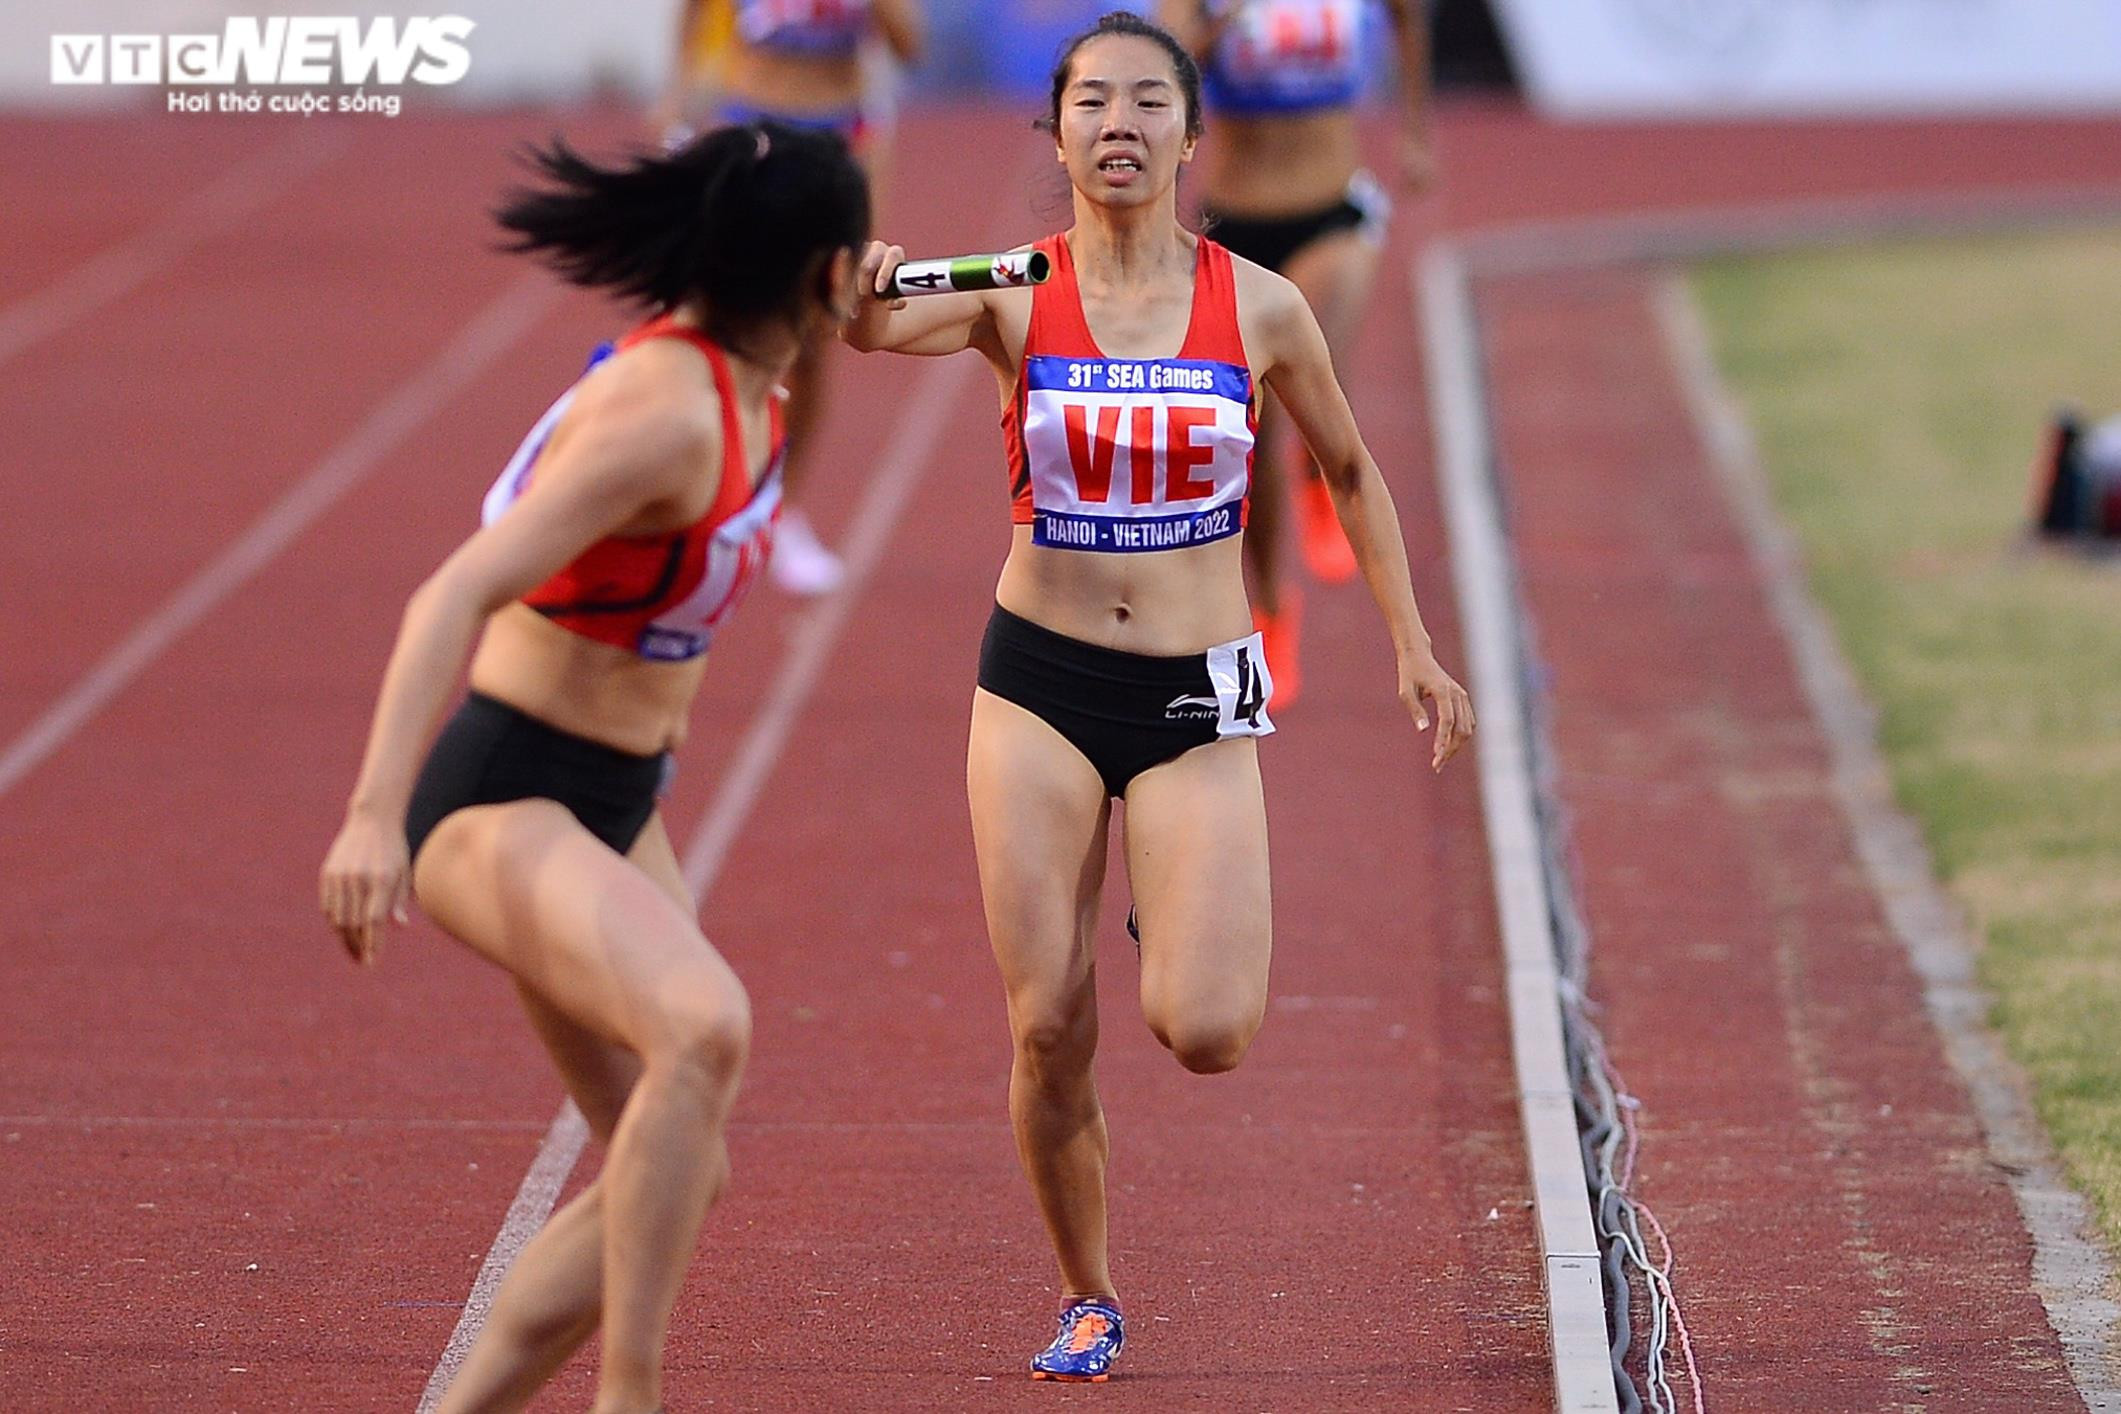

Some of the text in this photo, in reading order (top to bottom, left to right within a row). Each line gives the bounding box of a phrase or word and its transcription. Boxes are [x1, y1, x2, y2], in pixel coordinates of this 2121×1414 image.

[900, 272, 946, 288] 4
[1107, 365, 1145, 389] SEA
[1149, 365, 1214, 390] Games
[1063, 404, 1217, 505] VIE
[1046, 517, 1096, 546] HANOI
[1113, 521, 1190, 547] VIETNAM
[1194, 509, 1230, 540] 2022
[1233, 646, 1266, 729] 4
[1164, 710, 1220, 719] LI-NIN
